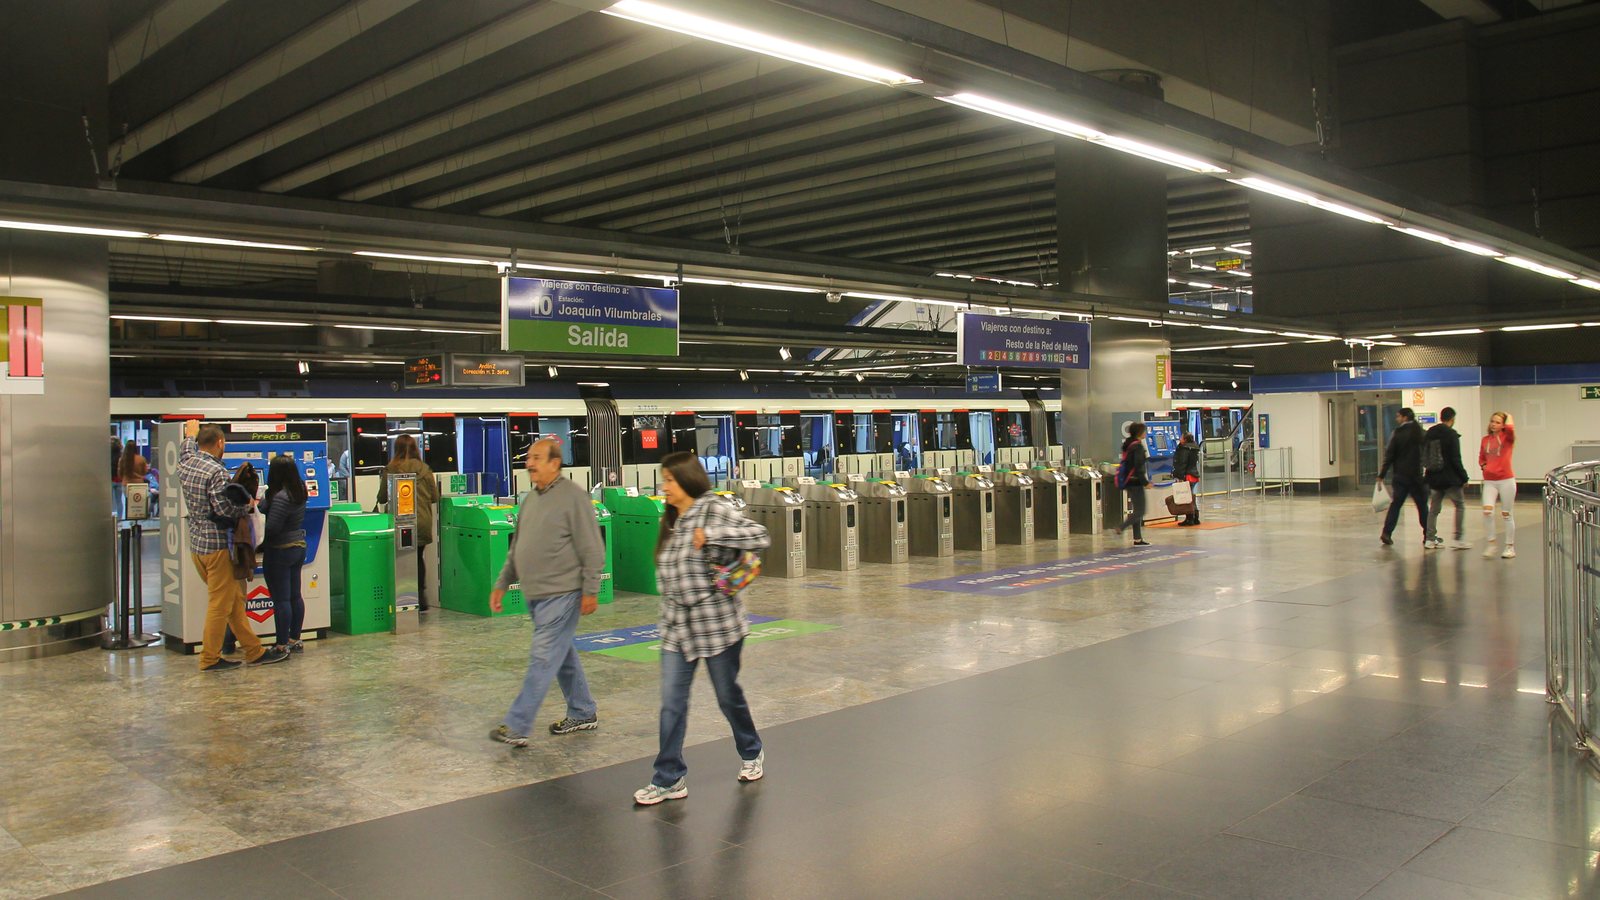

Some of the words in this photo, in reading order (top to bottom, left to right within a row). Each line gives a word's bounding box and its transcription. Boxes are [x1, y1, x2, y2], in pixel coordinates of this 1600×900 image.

[541, 279, 574, 290] Viajeros
[575, 283, 590, 292] con
[592, 284, 620, 294] destino
[622, 287, 629, 295] a:
[533, 295, 553, 316] 10
[558, 295, 584, 303] Estación:
[558, 304, 601, 319] Joaquín
[604, 306, 662, 322] Vilumbrales
[981, 321, 1008, 334] Viajeros
[1009, 325, 1021, 333] con
[1022, 325, 1045, 335] destino
[1046, 327, 1052, 335] a:
[567, 324, 628, 348] Salida
[1005, 339, 1024, 349] Resto
[1025, 340, 1033, 349] de
[1034, 341, 1040, 349] la
[1041, 341, 1053, 351] Red
[1054, 342, 1062, 351] de
[1062, 342, 1078, 352] Metro
[988, 351, 993, 360] 2
[995, 351, 1000, 360] 3
[1002, 351, 1007, 360] 4
[1009, 351, 1014, 360] 5
[1035, 353, 1040, 361] 9
[1041, 353, 1047, 361] 10
[1047, 353, 1053, 362] 11
[252, 432, 286, 440] Precio
[163, 441, 180, 604] Metro
[247, 600, 274, 610] Metro
[590, 636, 626, 644] 10
